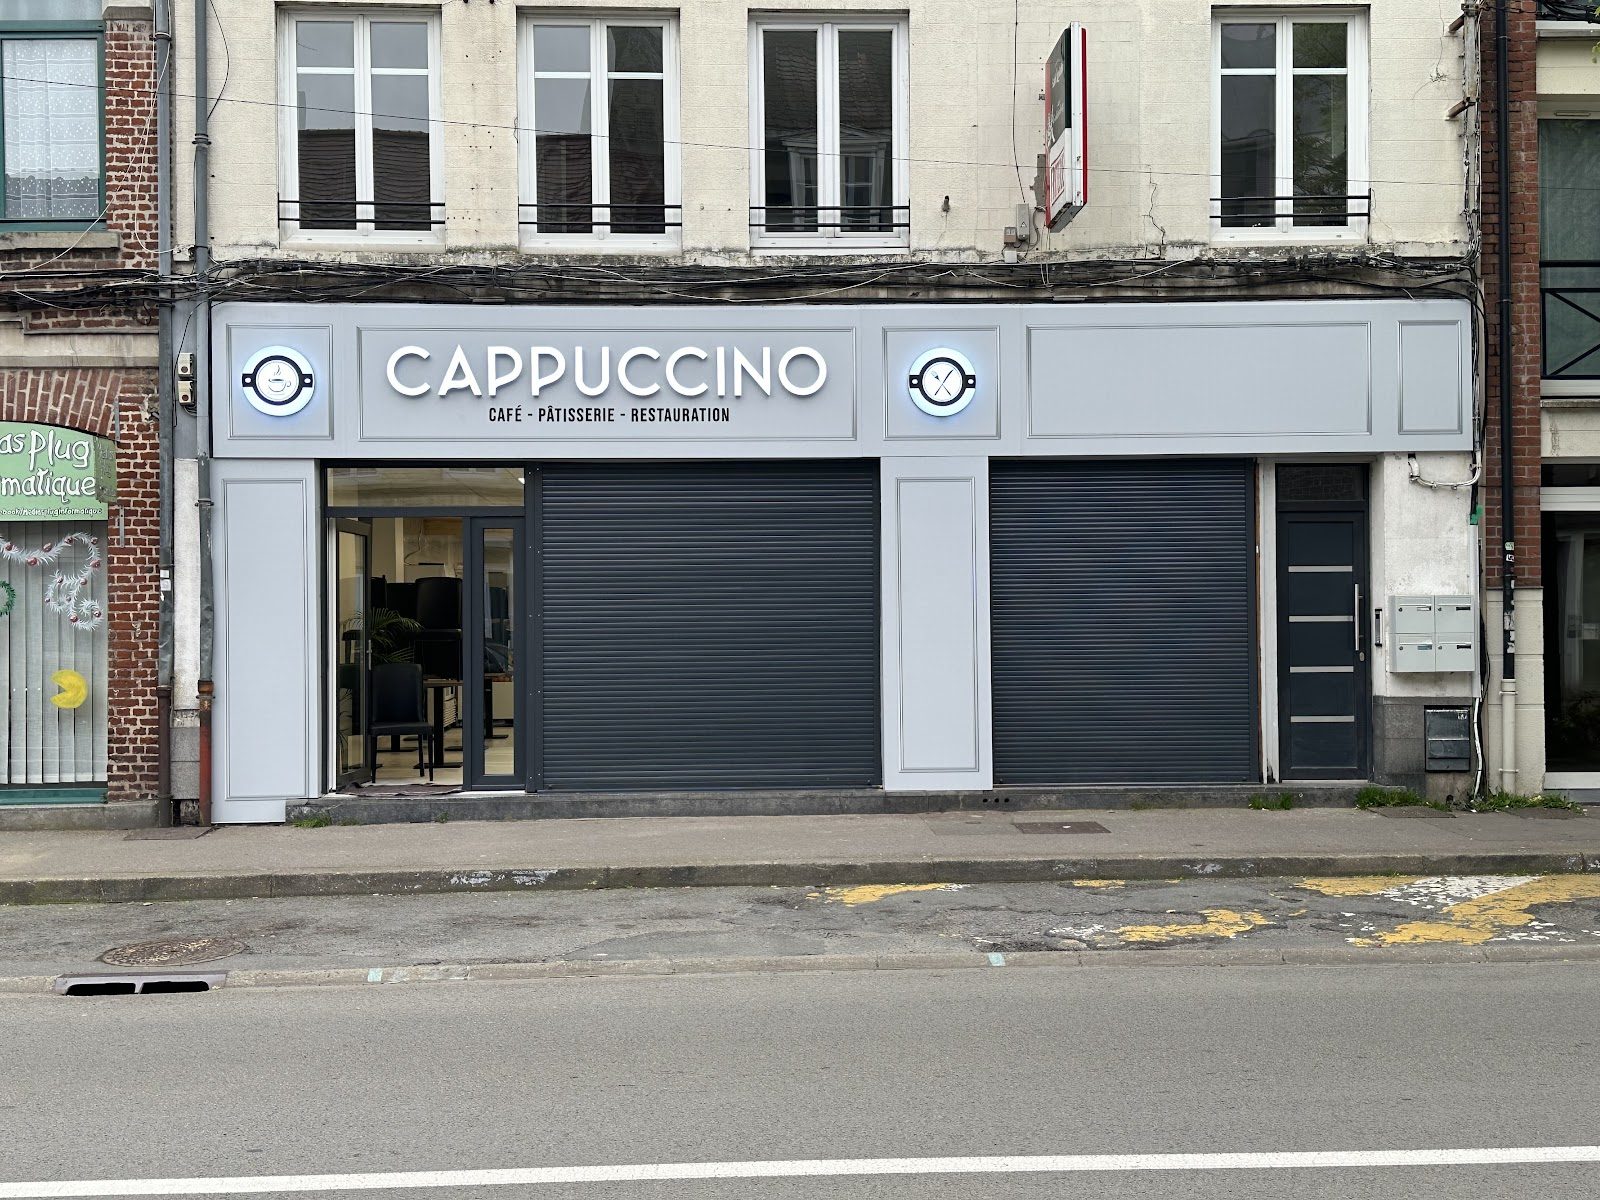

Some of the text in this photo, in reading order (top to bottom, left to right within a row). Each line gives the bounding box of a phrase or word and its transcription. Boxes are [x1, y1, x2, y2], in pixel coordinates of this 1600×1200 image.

[386, 344, 827, 397] CAPPUCCINO
[489, 405, 522, 422] CAFÉ
[538, 405, 615, 422] PÂTISSERIE
[631, 407, 730, 422] RESTAURATION
